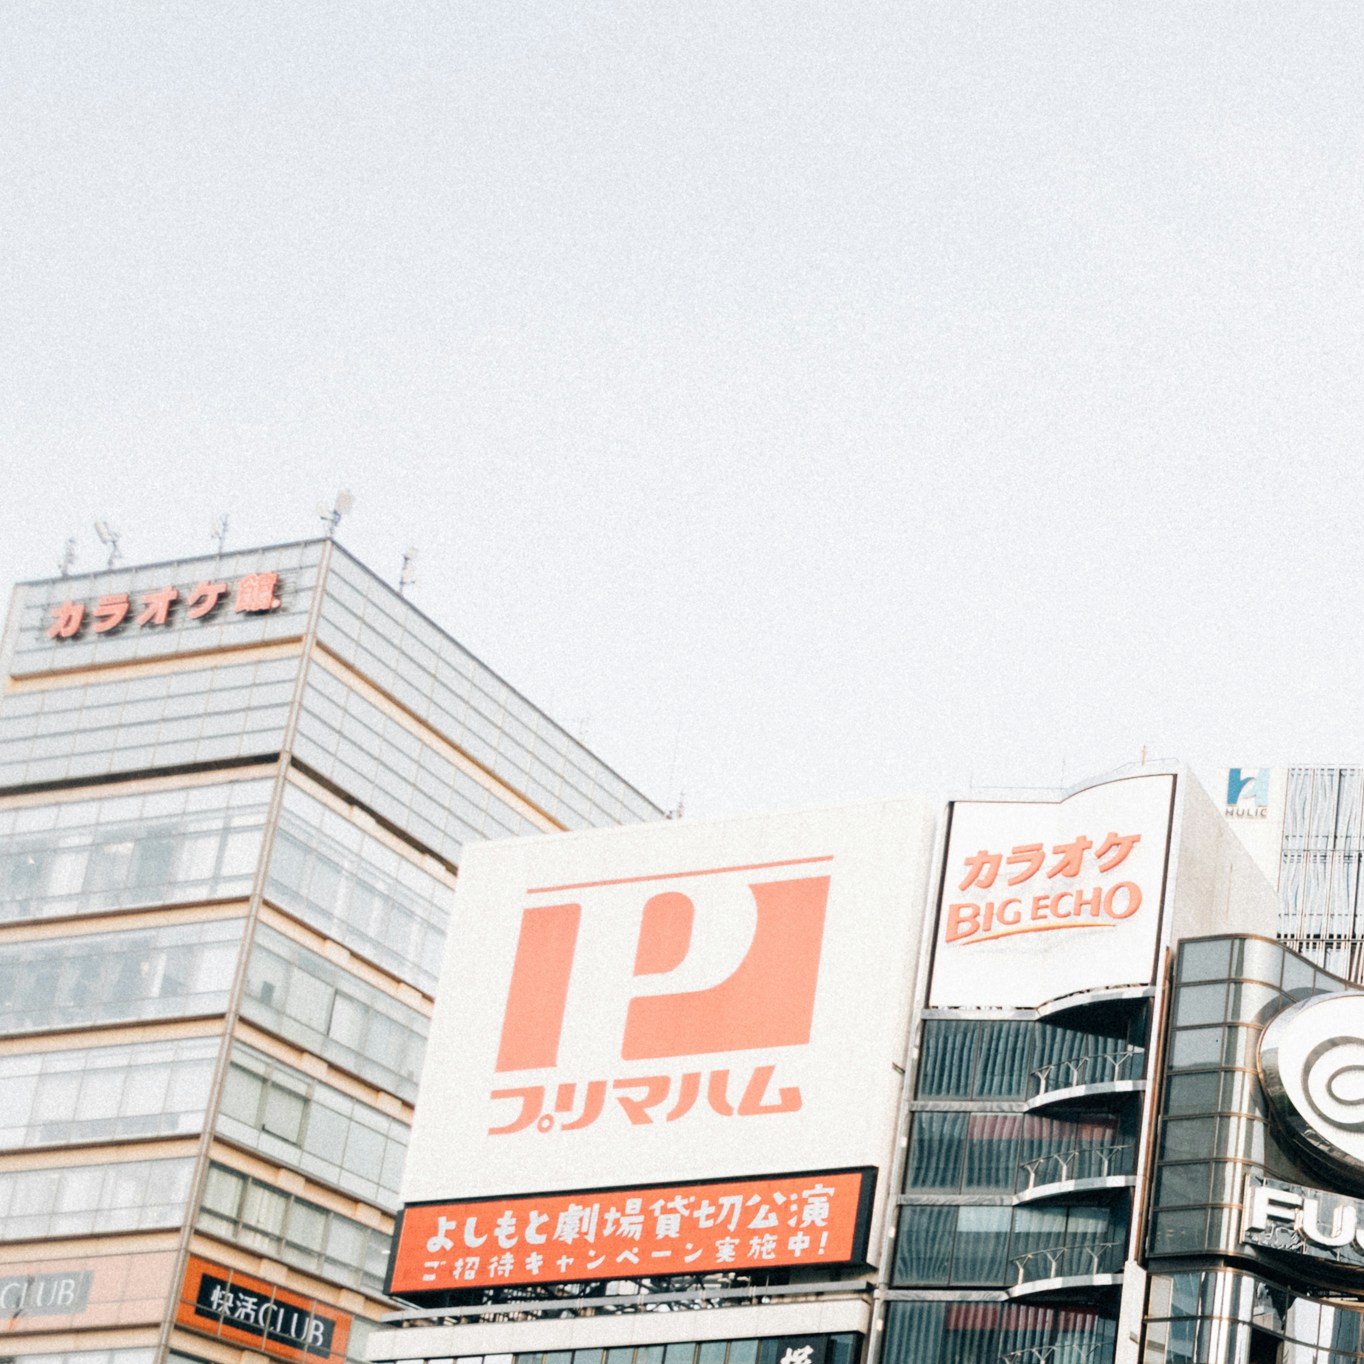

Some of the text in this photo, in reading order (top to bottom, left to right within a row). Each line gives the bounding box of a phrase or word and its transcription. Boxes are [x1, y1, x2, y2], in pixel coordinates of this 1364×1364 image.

[1225, 807, 1268, 818] HULIC
[958, 832, 1142, 892] カラオケ
[945, 881, 1143, 944] BIG ECHO
[487, 1064, 803, 1136] プリマハム
[426, 1184, 835, 1252] よしもと劇場貸切公演
[209, 1284, 325, 1347] 快活CLUB
